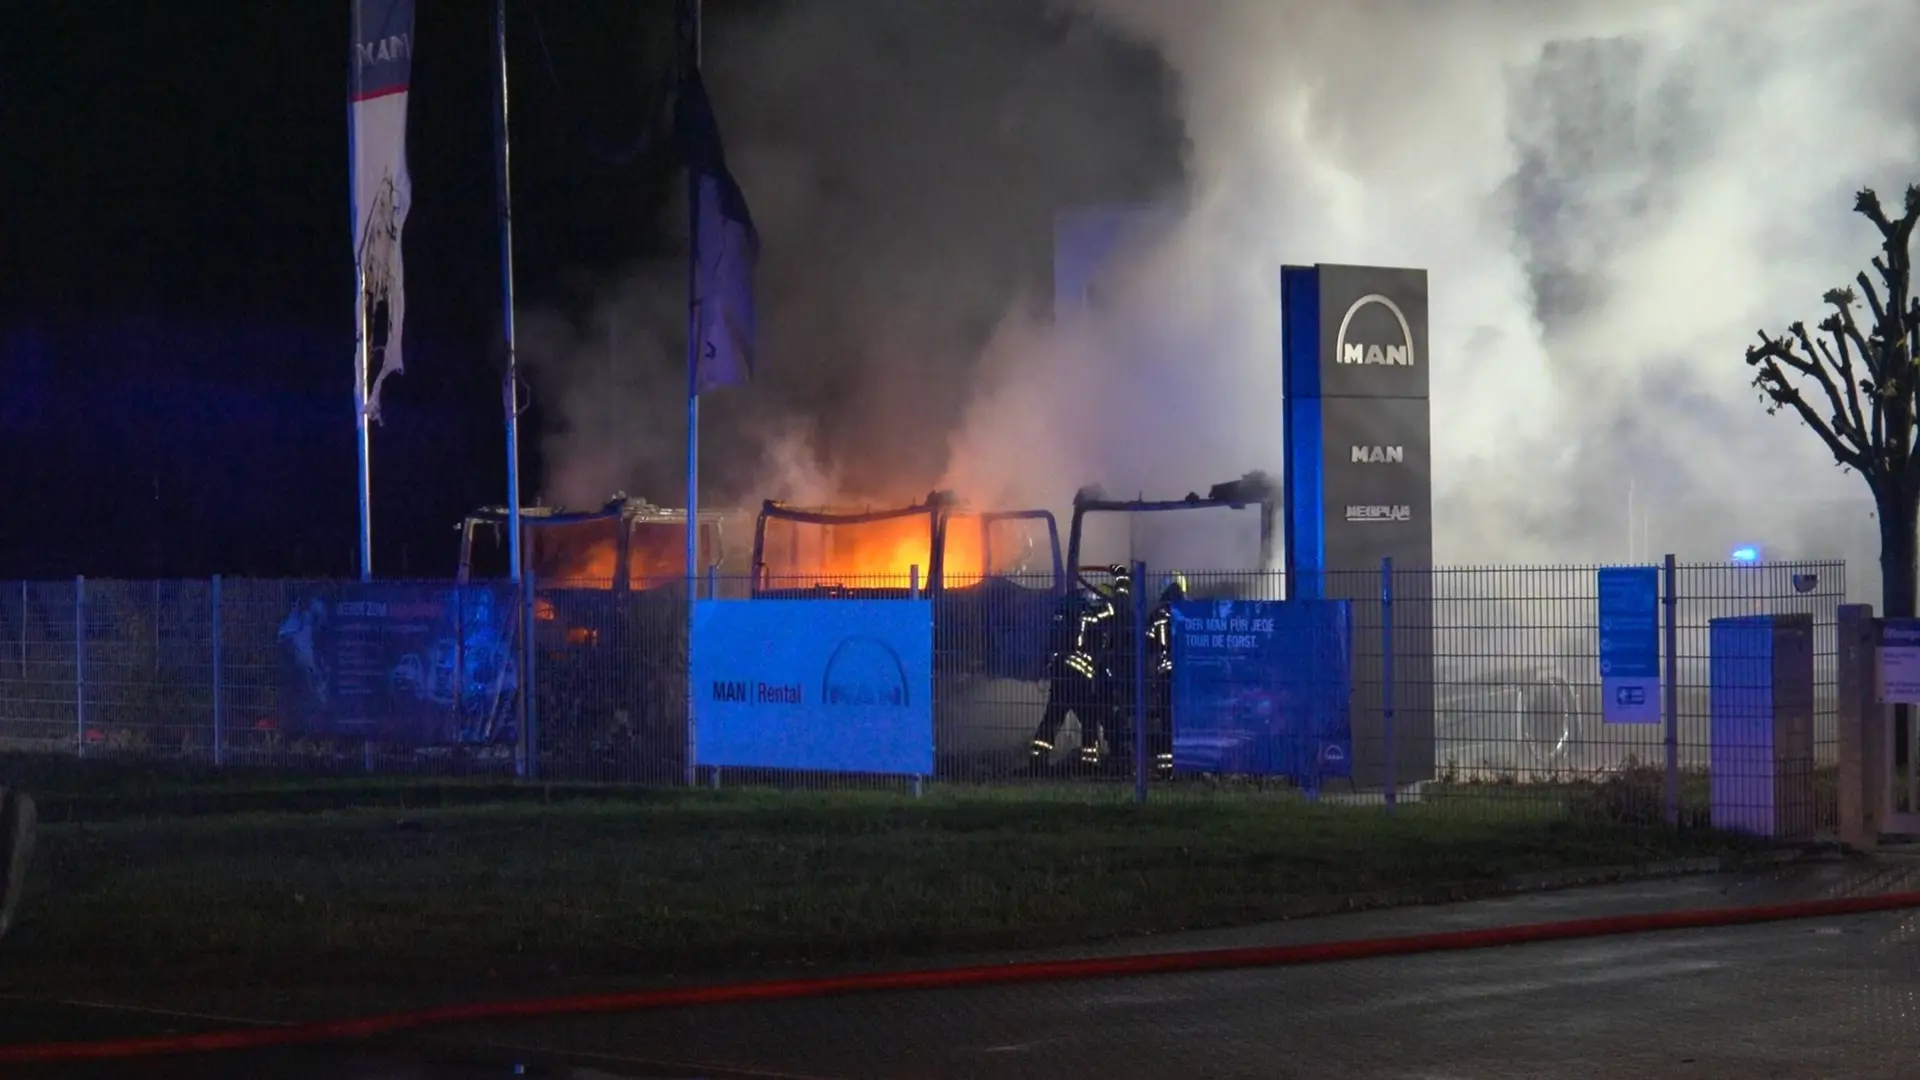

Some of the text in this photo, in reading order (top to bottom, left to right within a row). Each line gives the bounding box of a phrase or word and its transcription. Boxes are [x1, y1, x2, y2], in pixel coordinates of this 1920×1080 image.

[1344, 343, 1407, 365] MAN
[1351, 446, 1403, 463] MAN
[1346, 504, 1411, 521] NEOPLAN
[1184, 618, 1203, 632] DER
[1206, 618, 1228, 632] MAN
[1251, 618, 1275, 632] JEDE
[1185, 635, 1210, 648] TOUR
[1211, 635, 1224, 648] DE
[712, 681, 802, 704] MAN Rental
